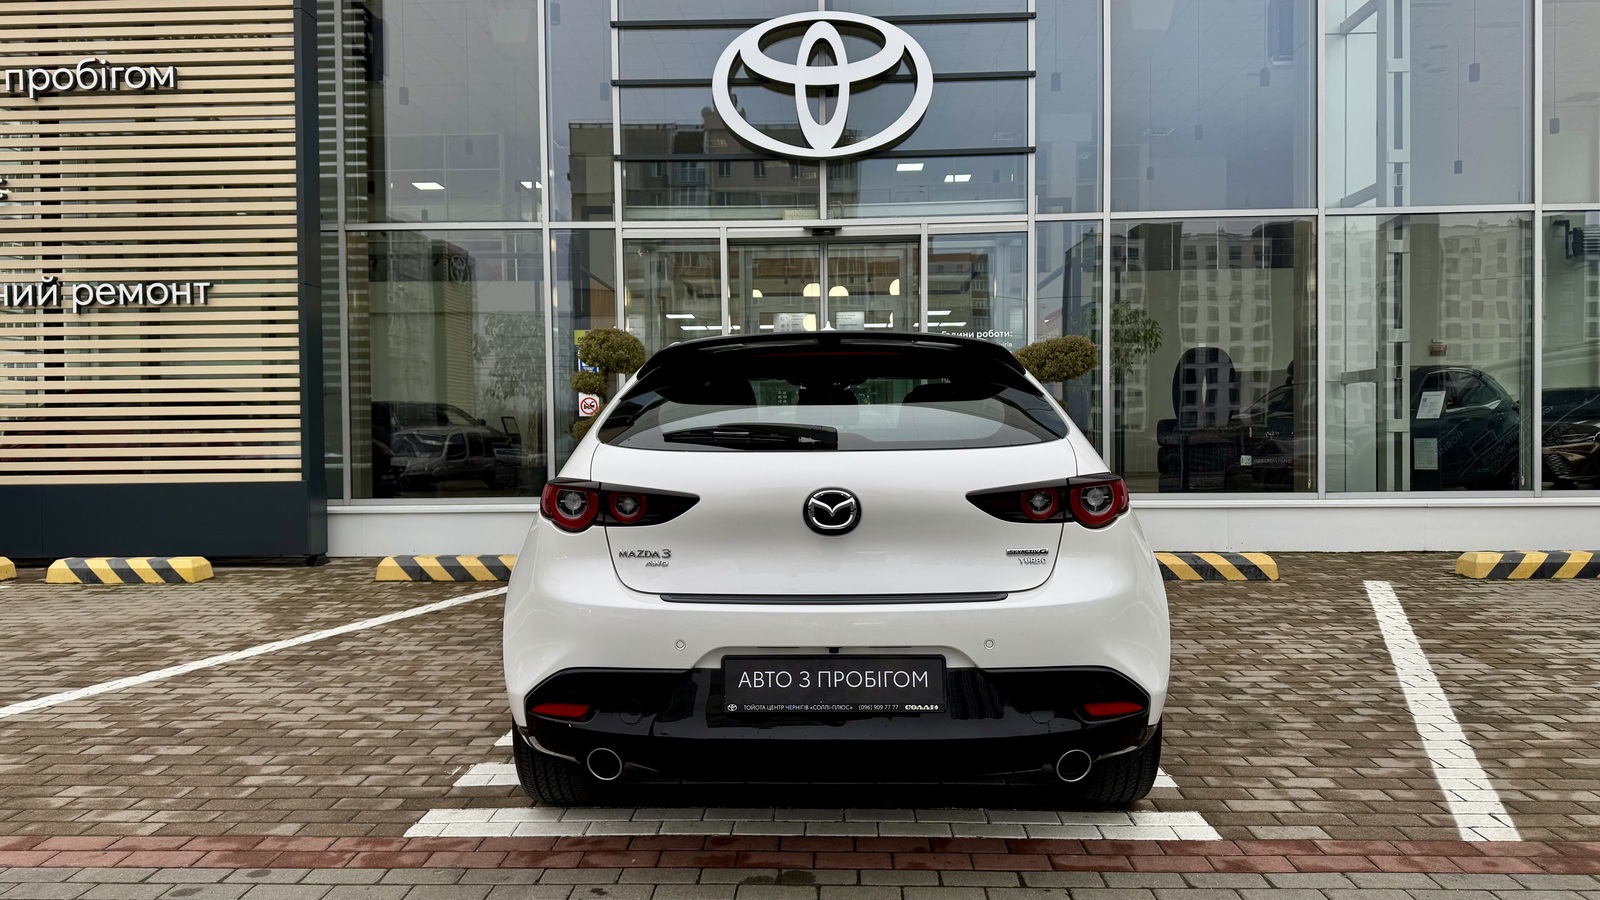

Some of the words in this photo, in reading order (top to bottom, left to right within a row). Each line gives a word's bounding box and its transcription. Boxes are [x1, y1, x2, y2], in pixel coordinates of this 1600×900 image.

[5, 58, 176, 99] пробігом
[73, 282, 210, 314] ремонт
[977, 329, 1013, 339] роботи:
[619, 549, 660, 558] MAZDA
[662, 548, 672, 559] 3
[1018, 557, 1047, 565] TURBO
[738, 671, 792, 688] АВТО
[818, 671, 928, 688] ПРОБІГОМ
[743, 703, 766, 711] ТОЙОТА
